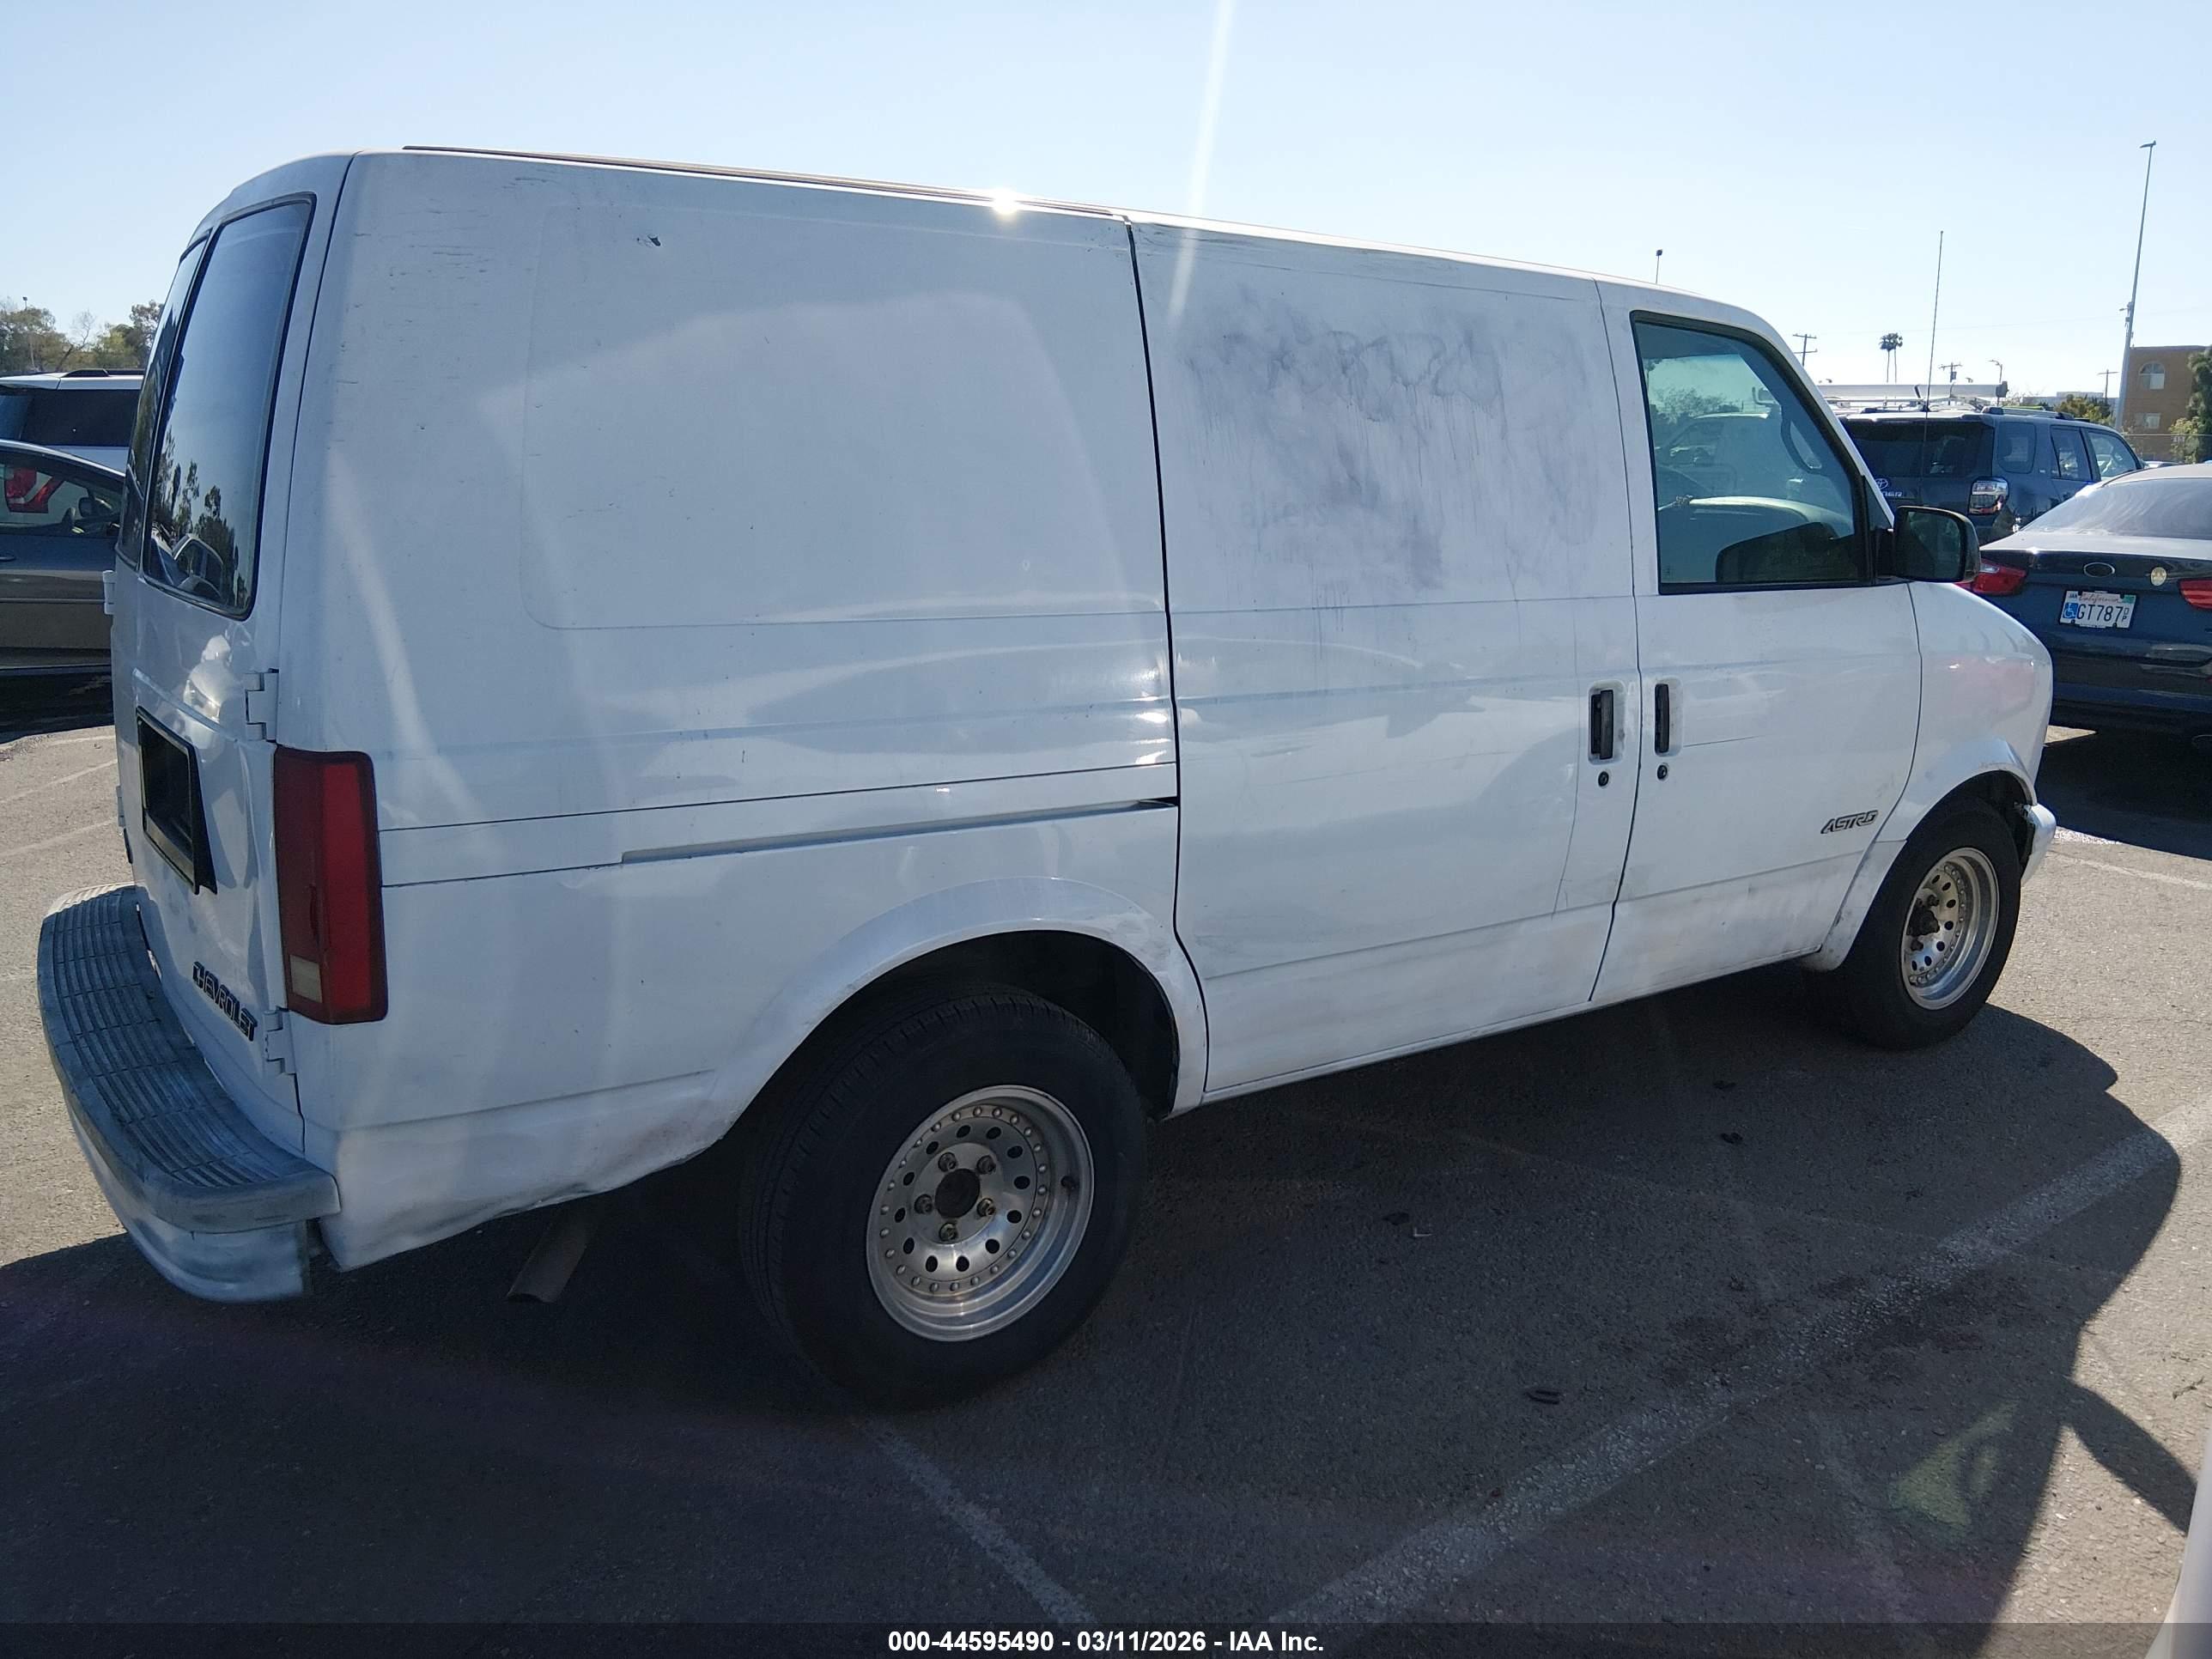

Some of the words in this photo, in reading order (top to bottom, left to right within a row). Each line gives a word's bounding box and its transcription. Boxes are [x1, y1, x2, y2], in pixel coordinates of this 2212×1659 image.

[2077, 604, 2124, 622] GT787
[1820, 810, 1879, 835] ASTRO
[192, 961, 258, 1042] CHEVROLET
